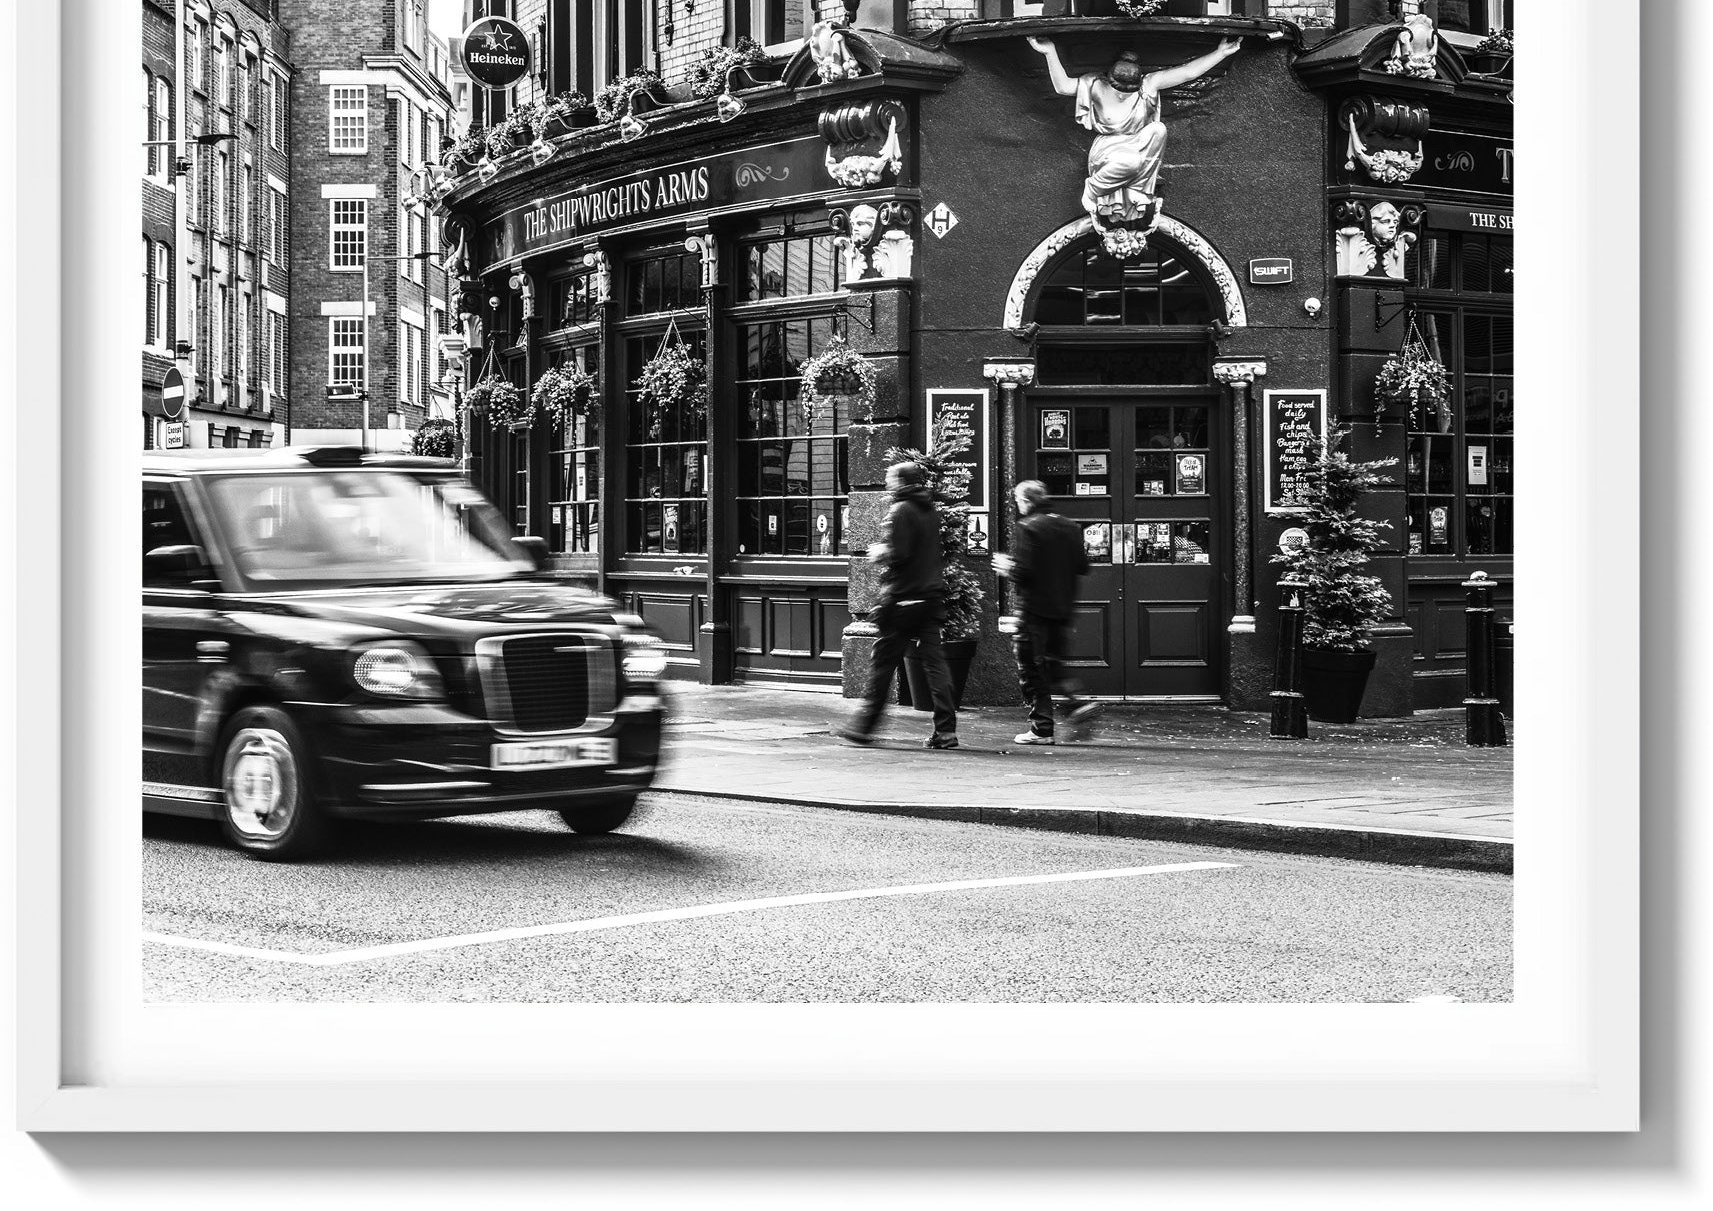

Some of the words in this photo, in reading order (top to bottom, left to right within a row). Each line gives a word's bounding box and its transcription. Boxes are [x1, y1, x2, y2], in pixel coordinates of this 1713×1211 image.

[470, 52, 525, 66] Heineken
[524, 207, 548, 242] THE
[550, 179, 651, 233] SHIPWRIGHTS
[654, 166, 709, 209] ARMS
[932, 210, 950, 230] H
[1469, 212, 1497, 228] THE
[937, 225, 943, 234] 9
[1254, 266, 1289, 276] SWIFT
[1277, 399, 1293, 410] Food
[1294, 400, 1315, 409] served
[1285, 409, 1307, 421] daily
[1280, 420, 1295, 431] Fish
[1296, 421, 1311, 430] and
[168, 436, 181, 445] cycles
[1286, 430, 1308, 440] chips
